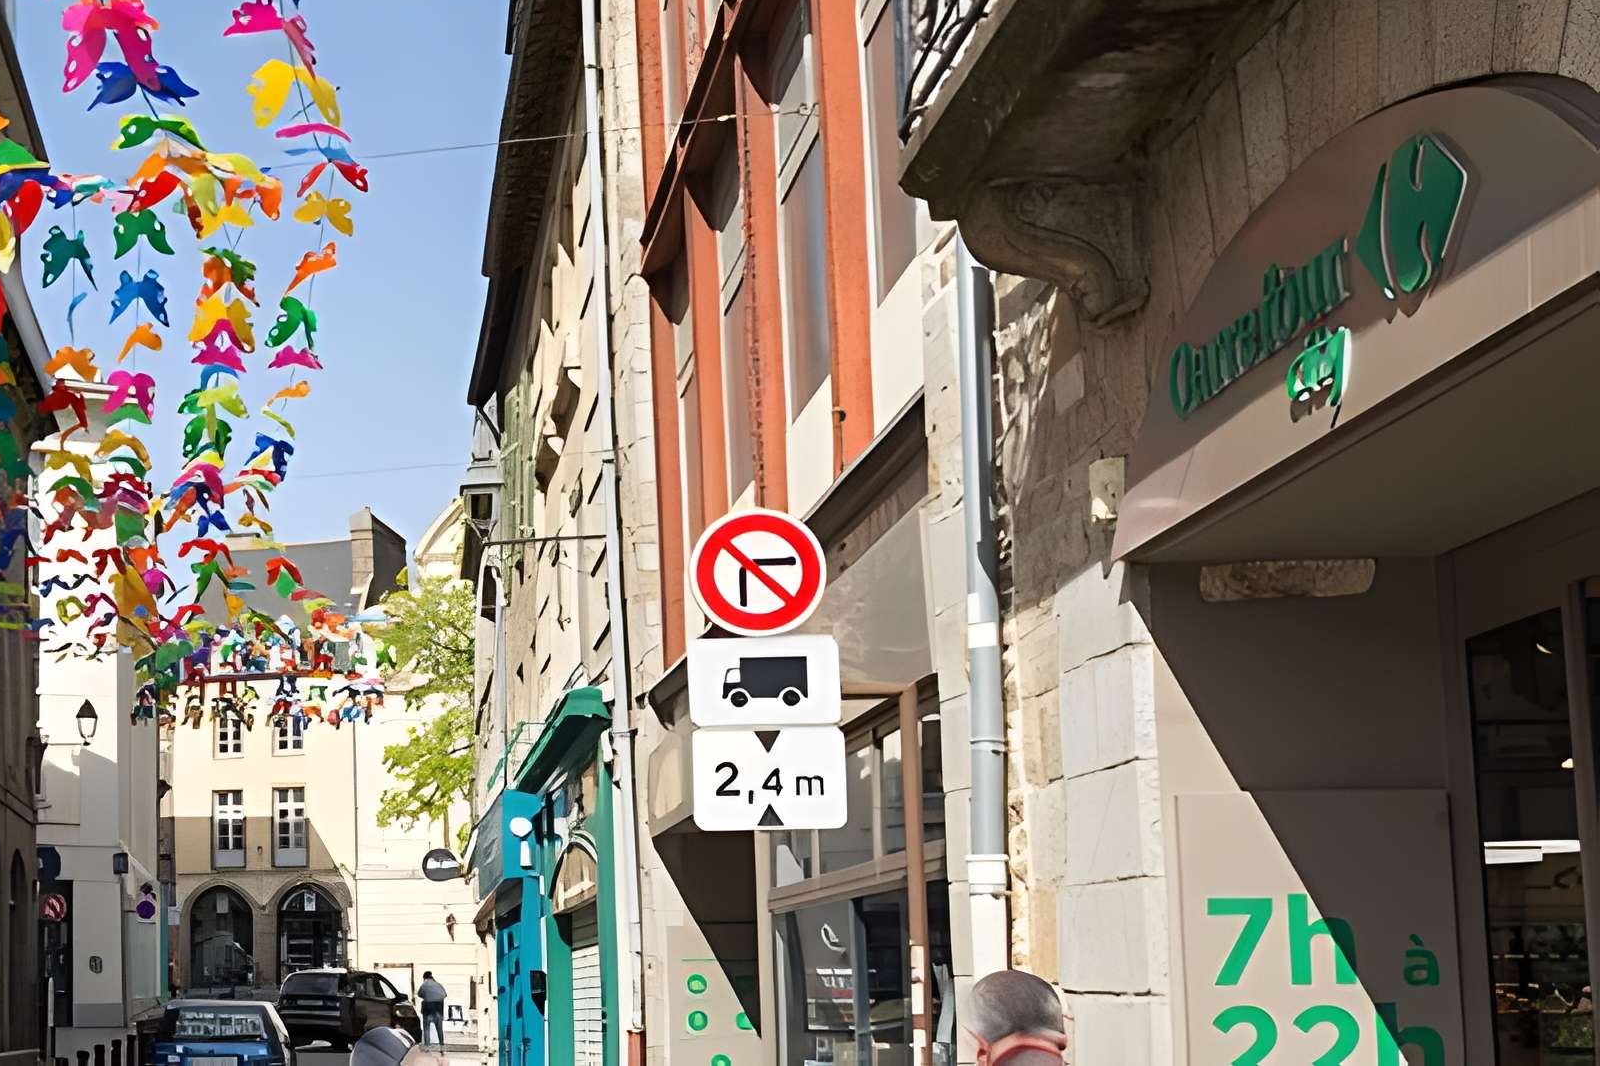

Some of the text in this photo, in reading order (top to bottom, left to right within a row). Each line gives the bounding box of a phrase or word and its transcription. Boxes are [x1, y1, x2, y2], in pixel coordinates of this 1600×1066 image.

[715, 761, 824, 804] 2,4 m
[1207, 893, 1440, 986] 7h à
